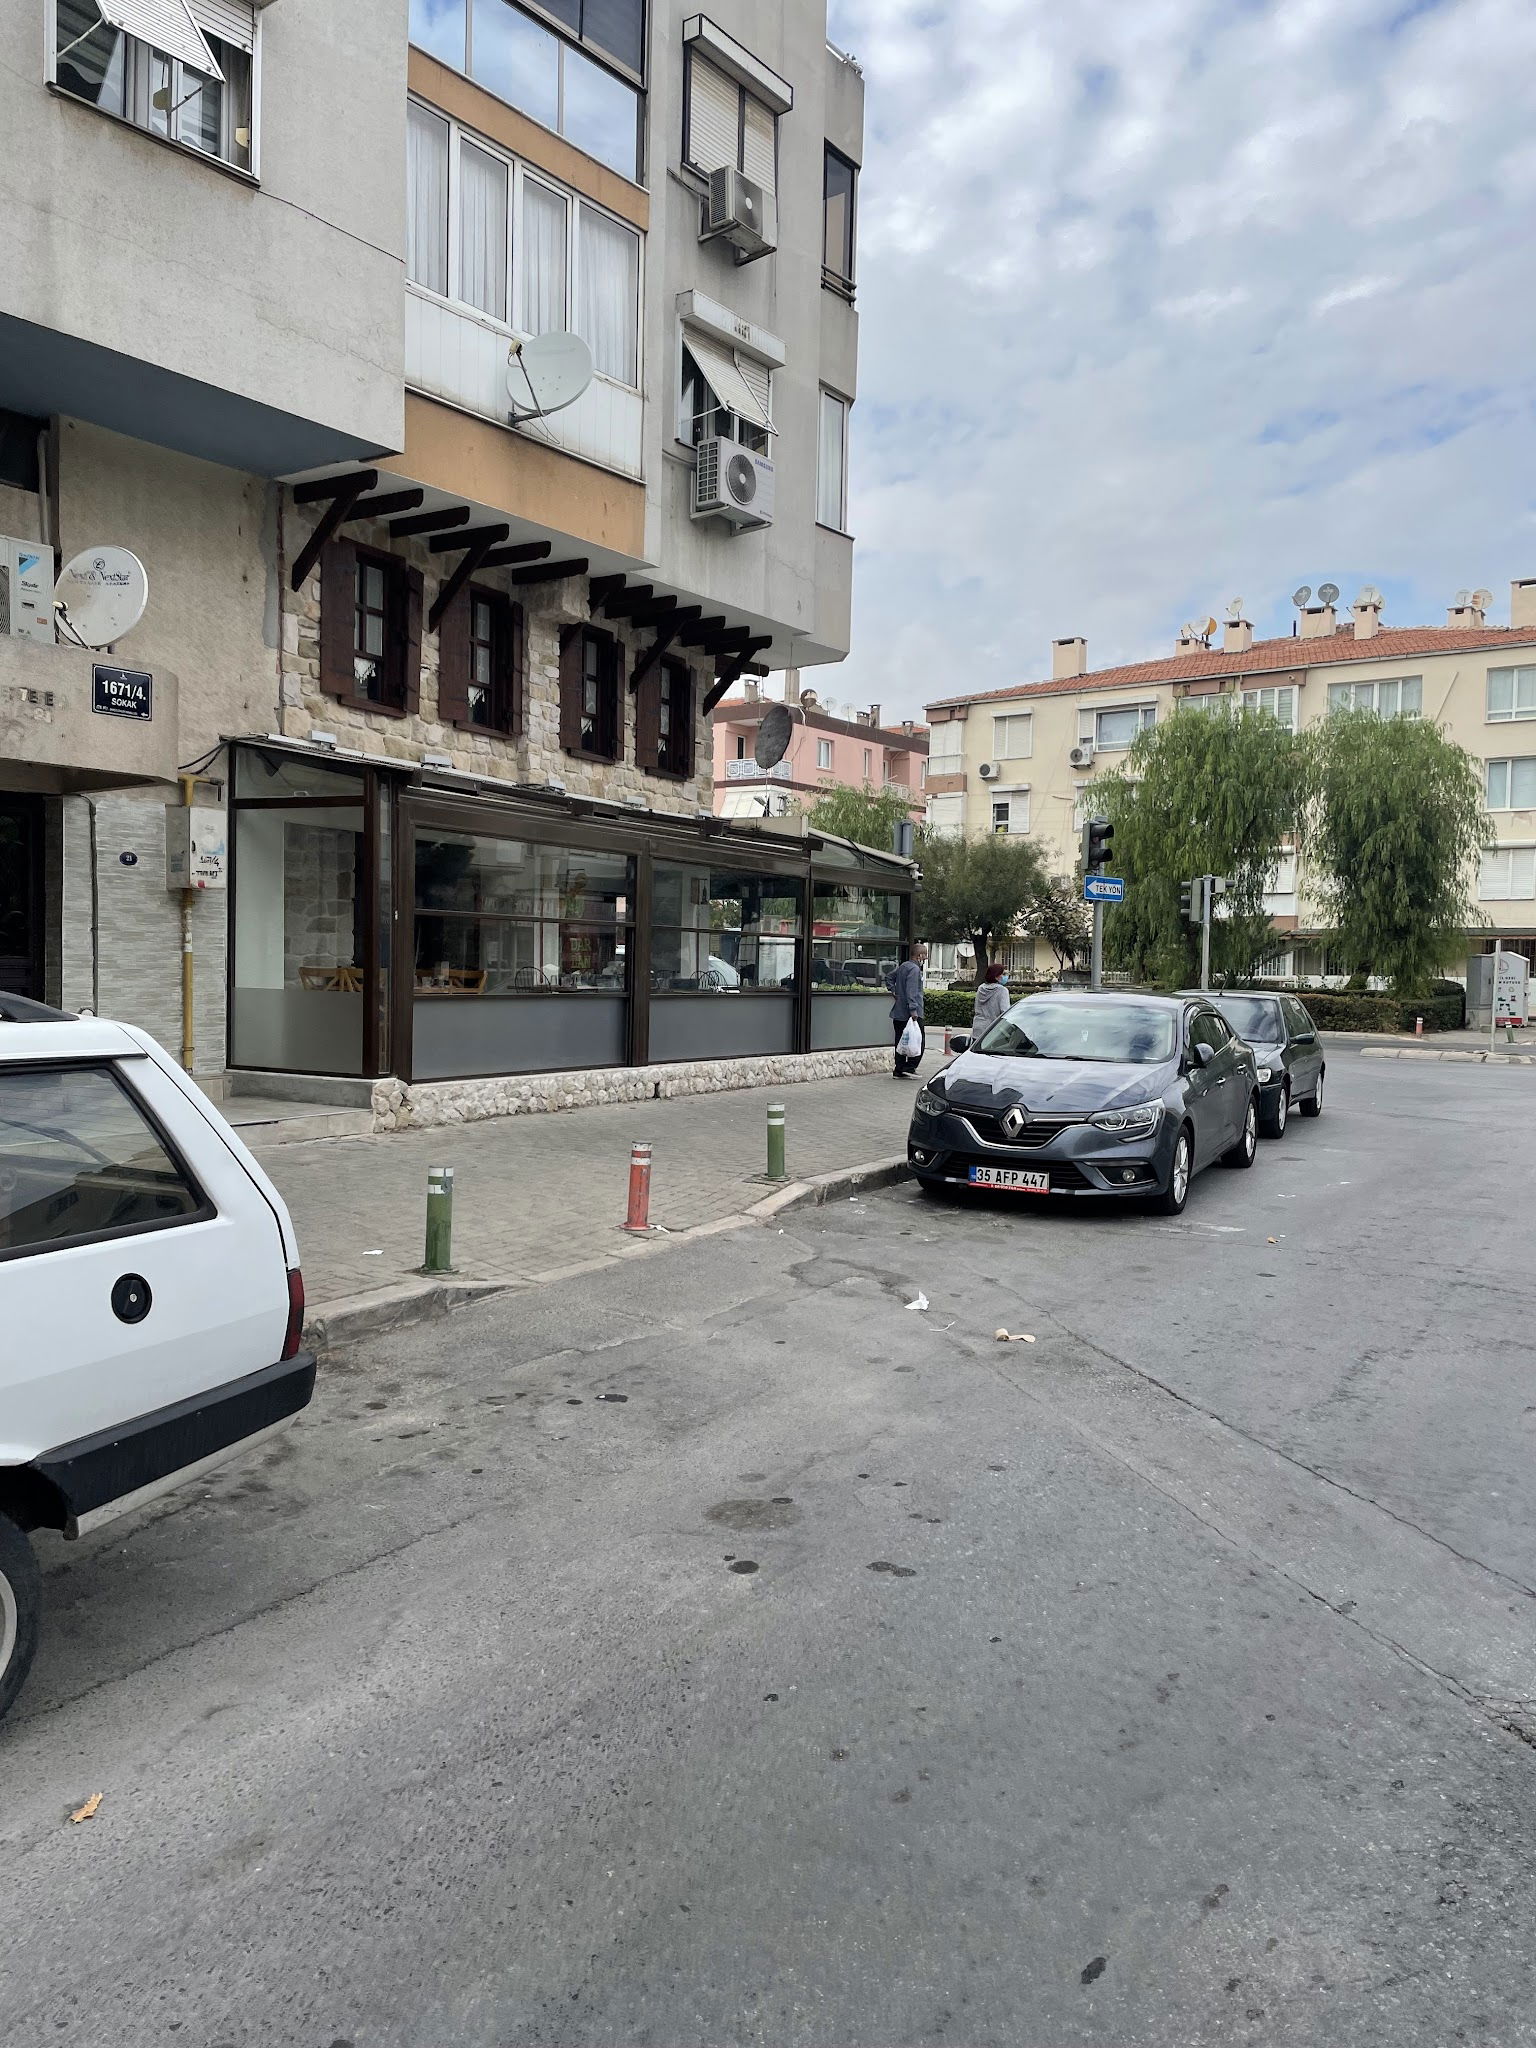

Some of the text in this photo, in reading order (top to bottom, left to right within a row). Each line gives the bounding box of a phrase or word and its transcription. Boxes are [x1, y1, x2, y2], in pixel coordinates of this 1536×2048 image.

[111, 697, 137, 709] SOKAK
[1095, 884, 1108, 893] TEK
[977, 1168, 991, 1182] 35
[995, 1170, 1018, 1185] AFP
[1022, 1173, 1046, 1188] 447
